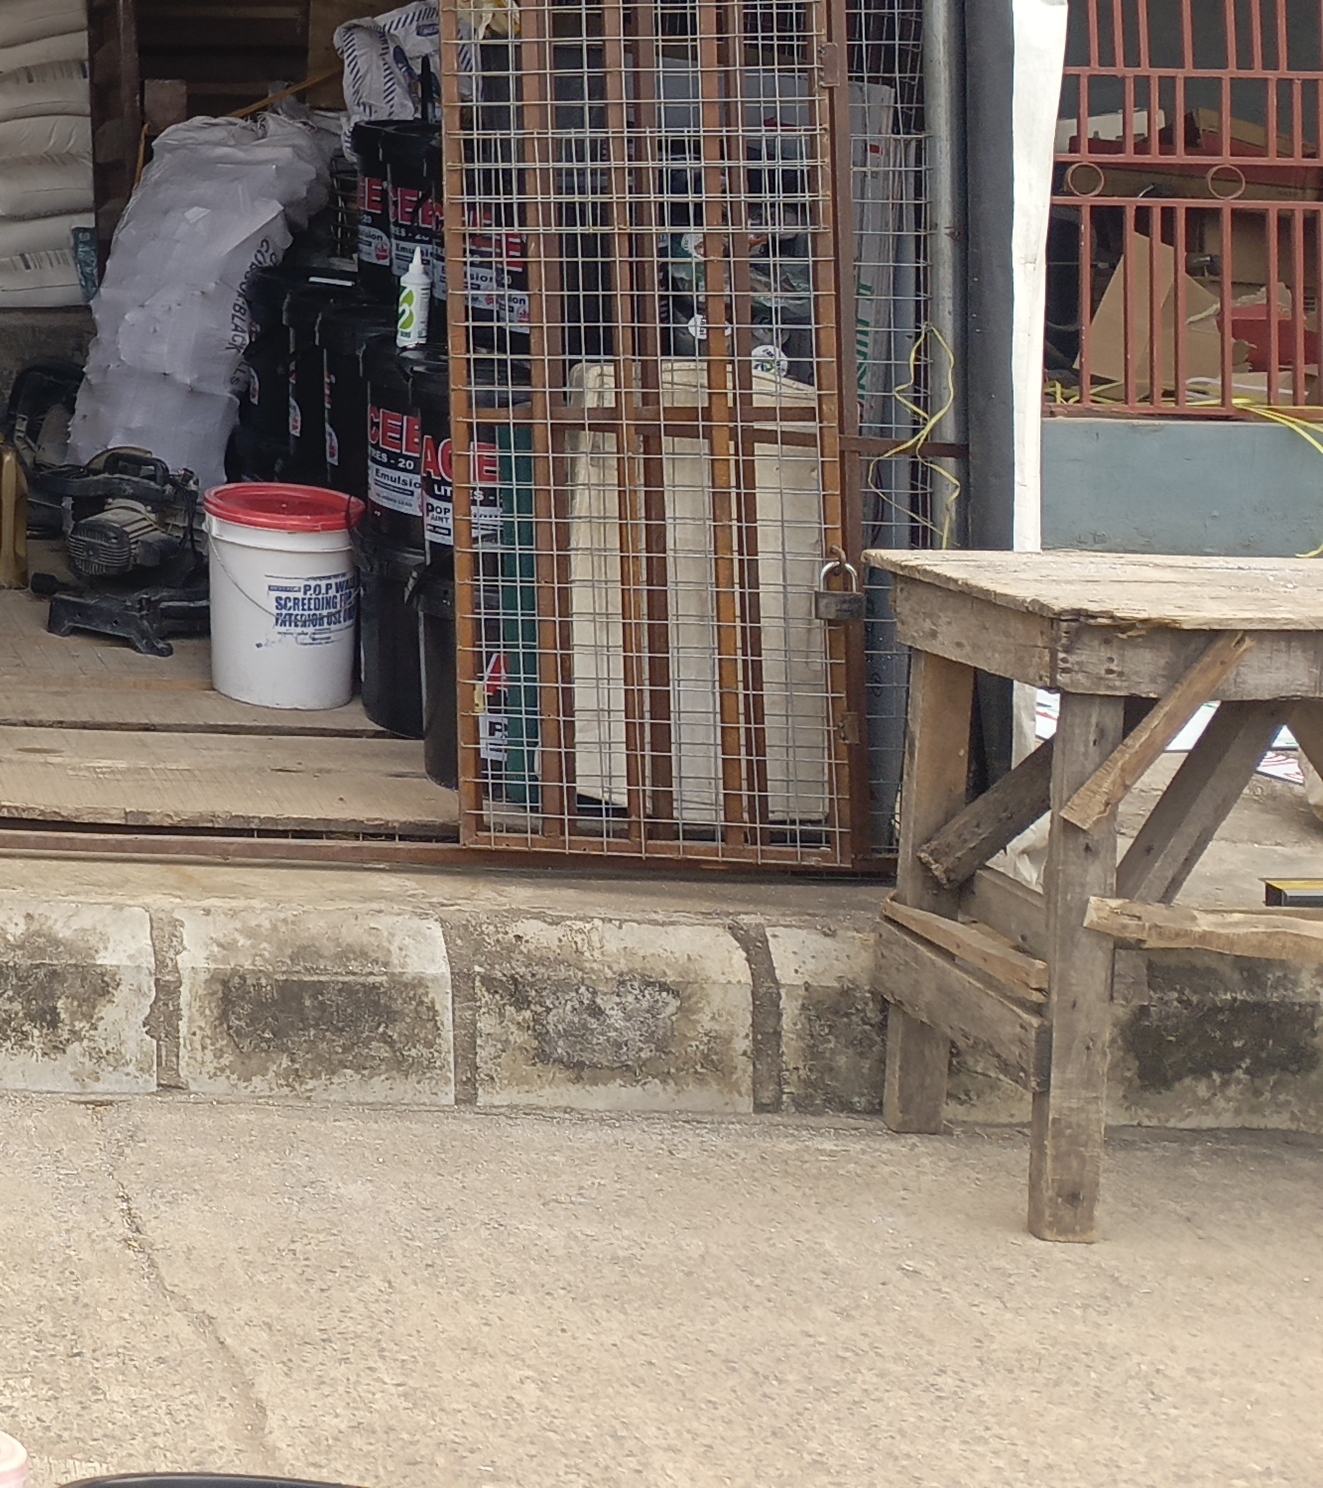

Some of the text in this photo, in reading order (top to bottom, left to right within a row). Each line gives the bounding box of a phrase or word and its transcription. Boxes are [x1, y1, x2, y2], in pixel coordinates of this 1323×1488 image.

[398, 458, 414, 469] 20
[422, 435, 498, 483] ACE
[275, 595, 338, 612] SCREEDING
